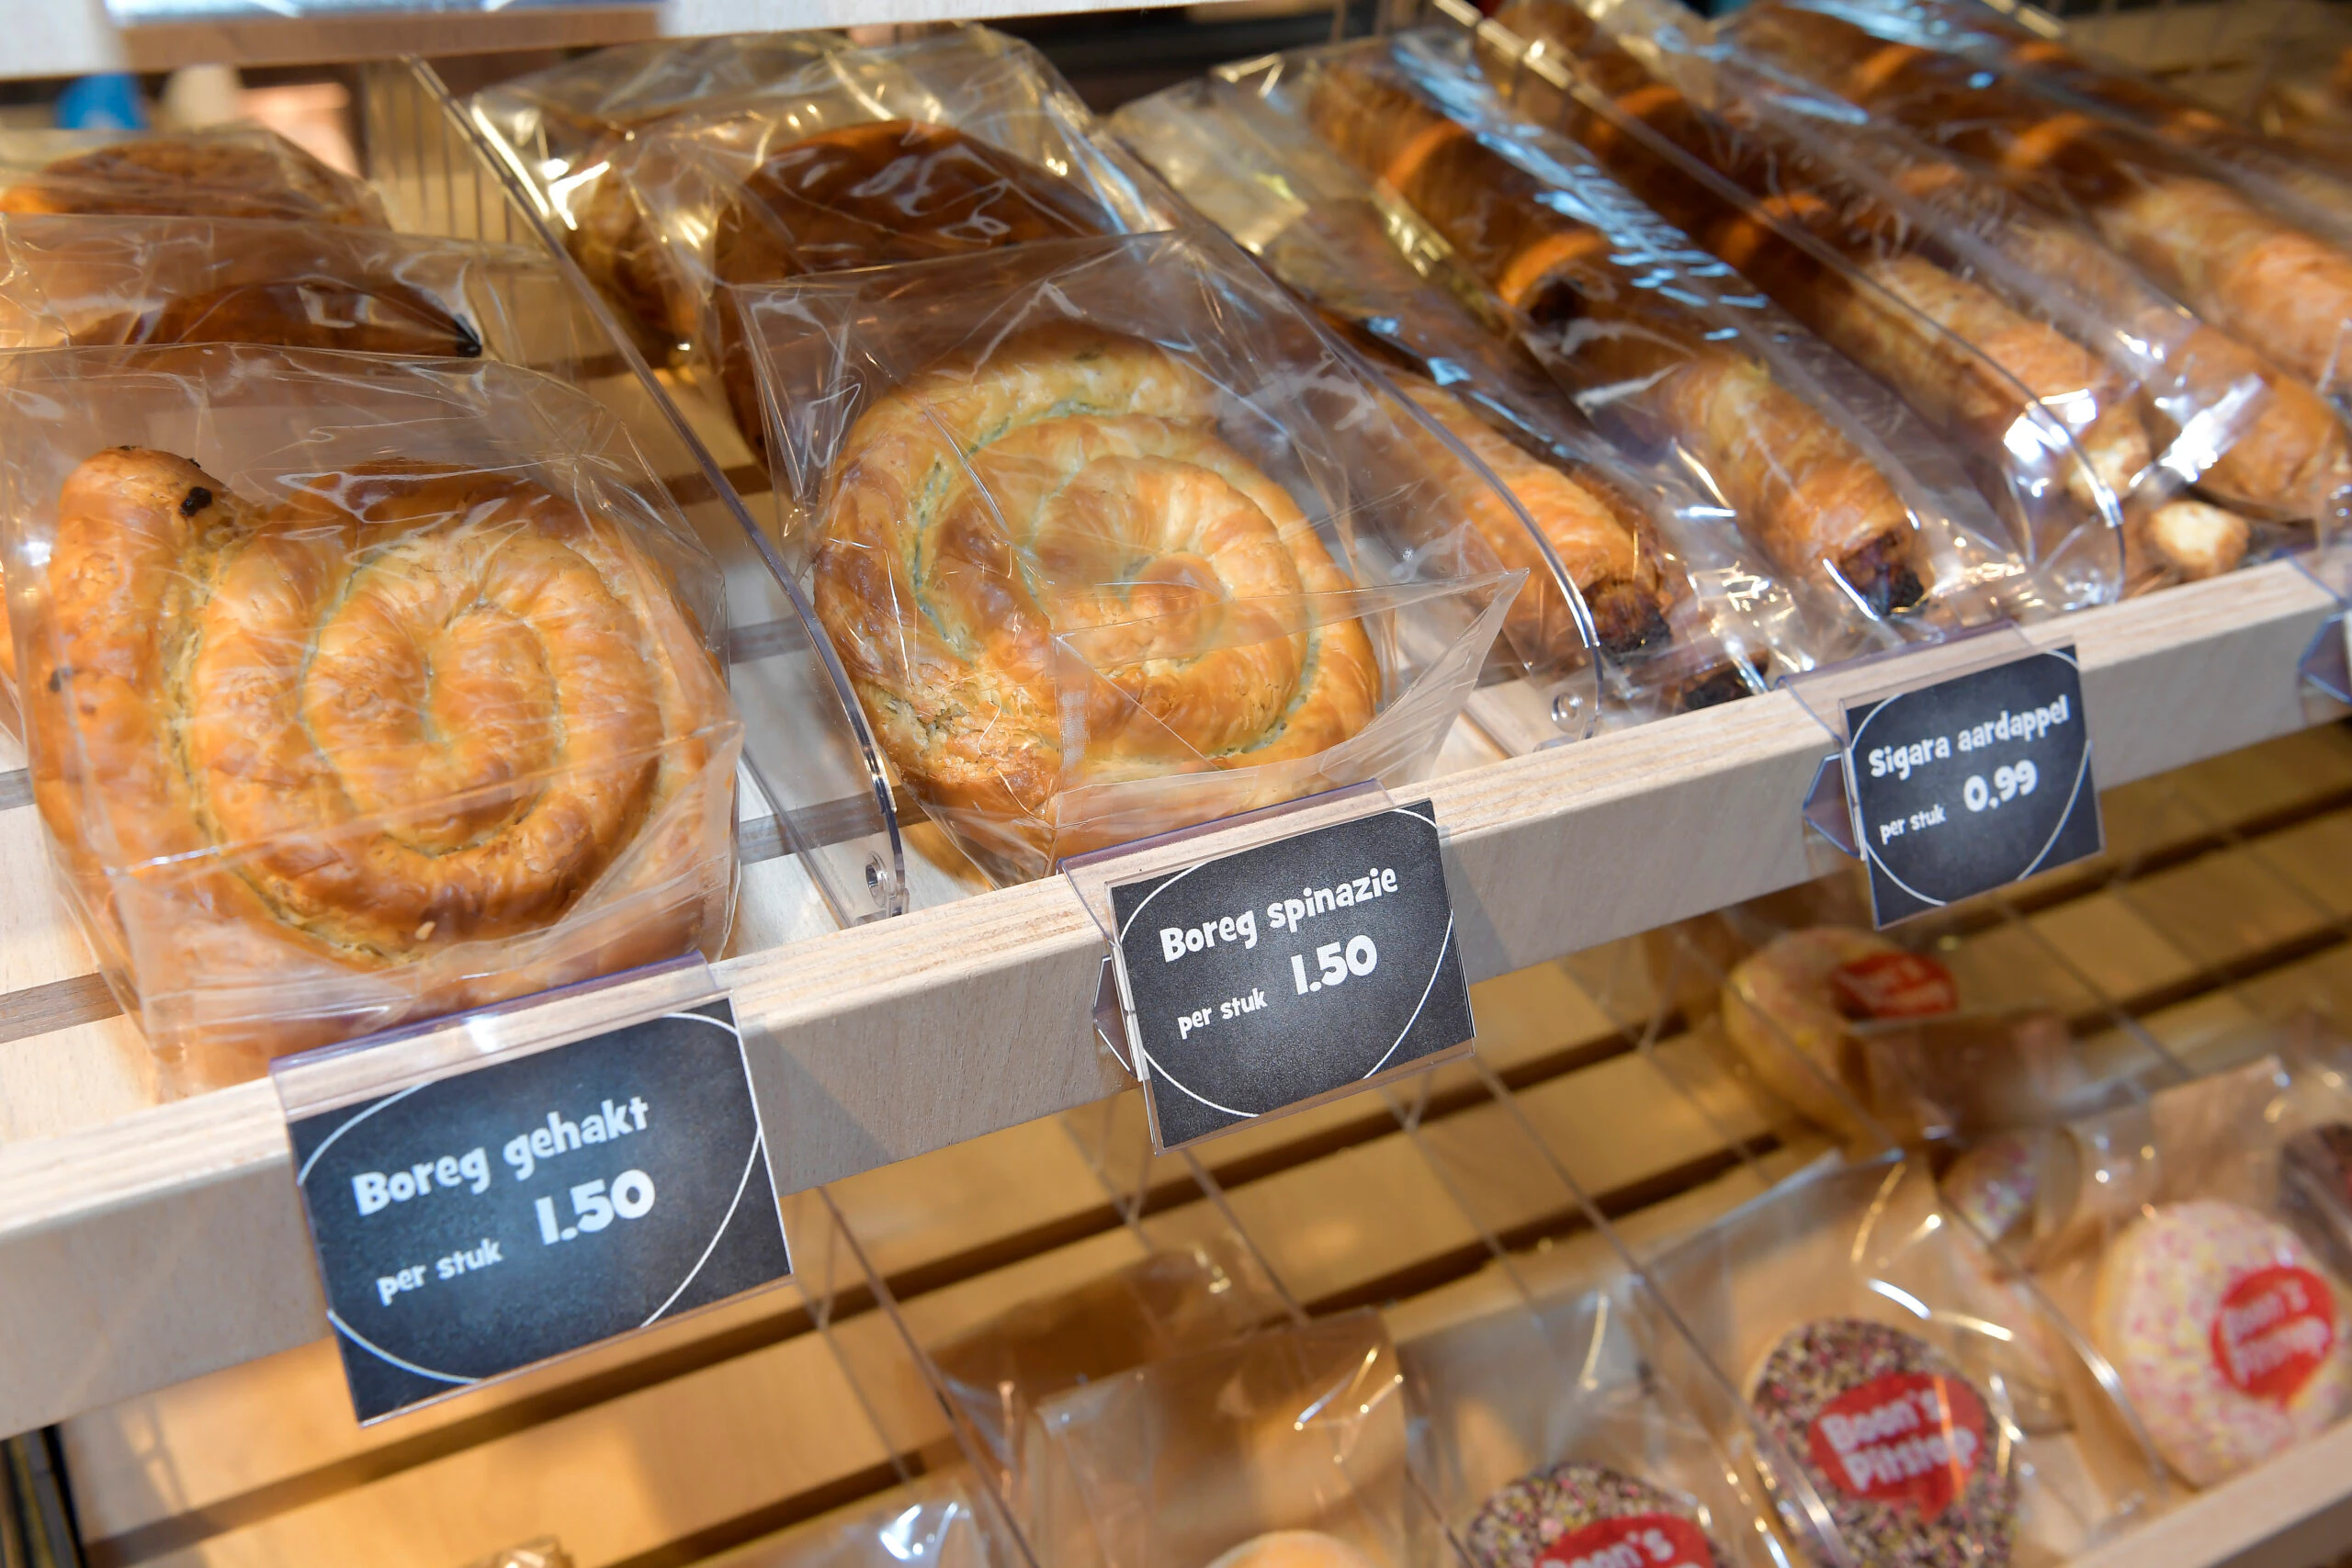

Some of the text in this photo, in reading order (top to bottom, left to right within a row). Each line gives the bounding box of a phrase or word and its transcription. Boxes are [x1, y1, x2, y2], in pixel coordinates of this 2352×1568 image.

[1868, 694, 2069, 780] Sigara aardappel
[1962, 760, 2038, 812] 0.99
[1879, 803, 1946, 845] per stuk
[1159, 867, 1398, 963] Boreg spinazie
[1290, 934, 1378, 996] 1.50
[1177, 987, 1268, 1040] per stuk
[351, 1096, 649, 1216] Boreg gehakt
[534, 1168, 657, 1246] 1.50
[376, 1237, 503, 1305] per stuk
